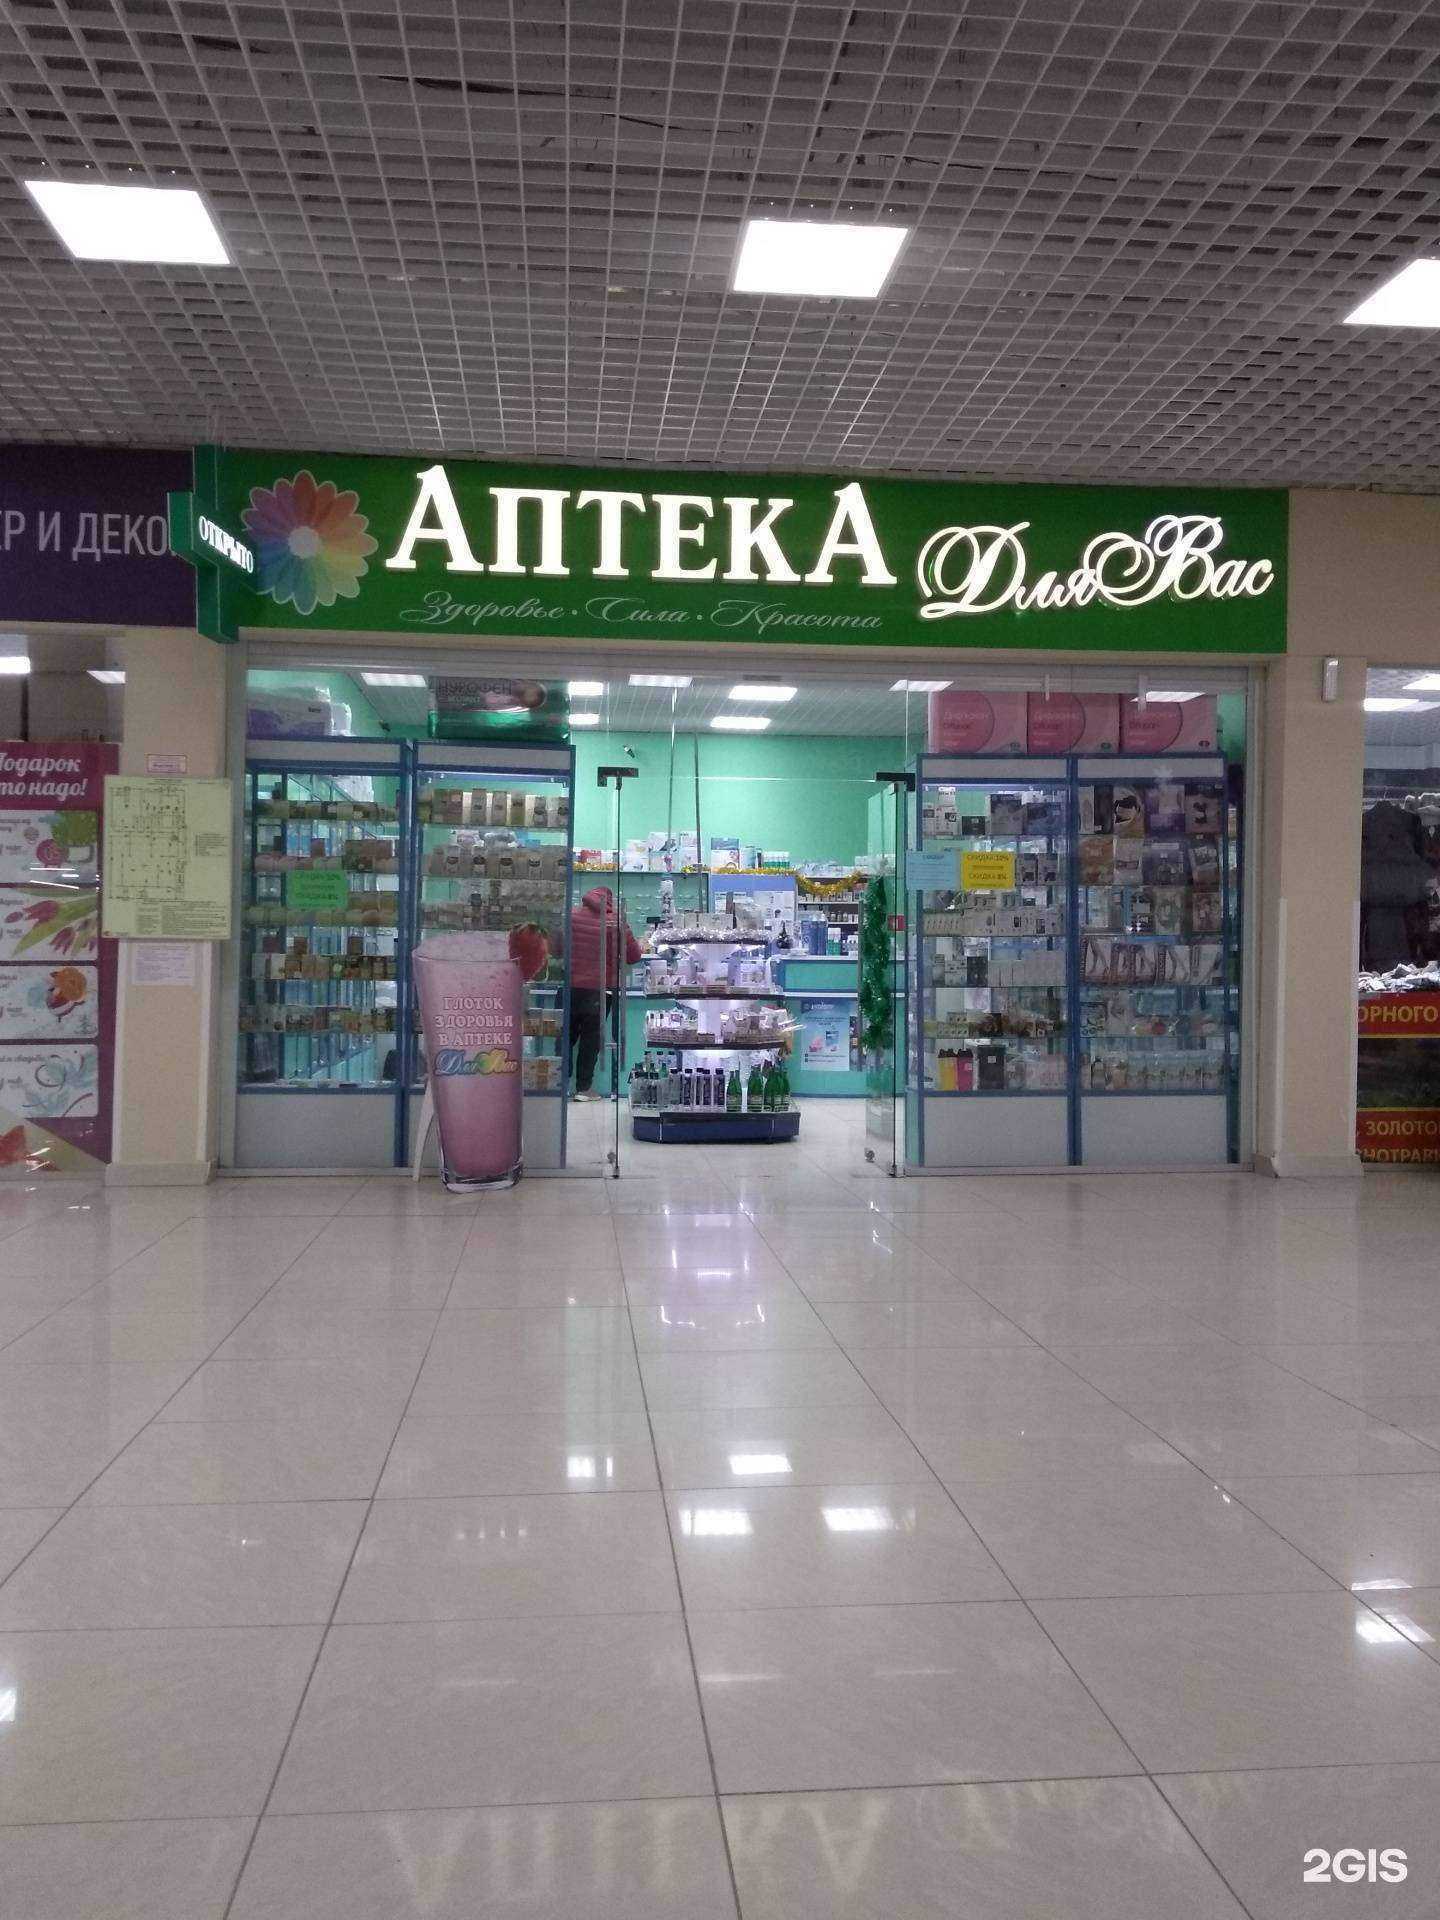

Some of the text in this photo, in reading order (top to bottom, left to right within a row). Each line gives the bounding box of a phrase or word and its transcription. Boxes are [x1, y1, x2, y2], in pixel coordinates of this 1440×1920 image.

[0, 510, 174, 561] Р И ДЕКО
[199, 515, 253, 574] ОТКРЫТО
[386, 465, 1274, 619] АПТЕКА Для Вас
[400, 590, 884, 633] Здоровье Сила Красота
[28, 778, 88, 802] надо!
[442, 996, 504, 1011] ГЛОТОК
[434, 1014, 514, 1029] ЗДОРОВЬЯ
[439, 1032, 513, 1047] В АПТЕКЕ
